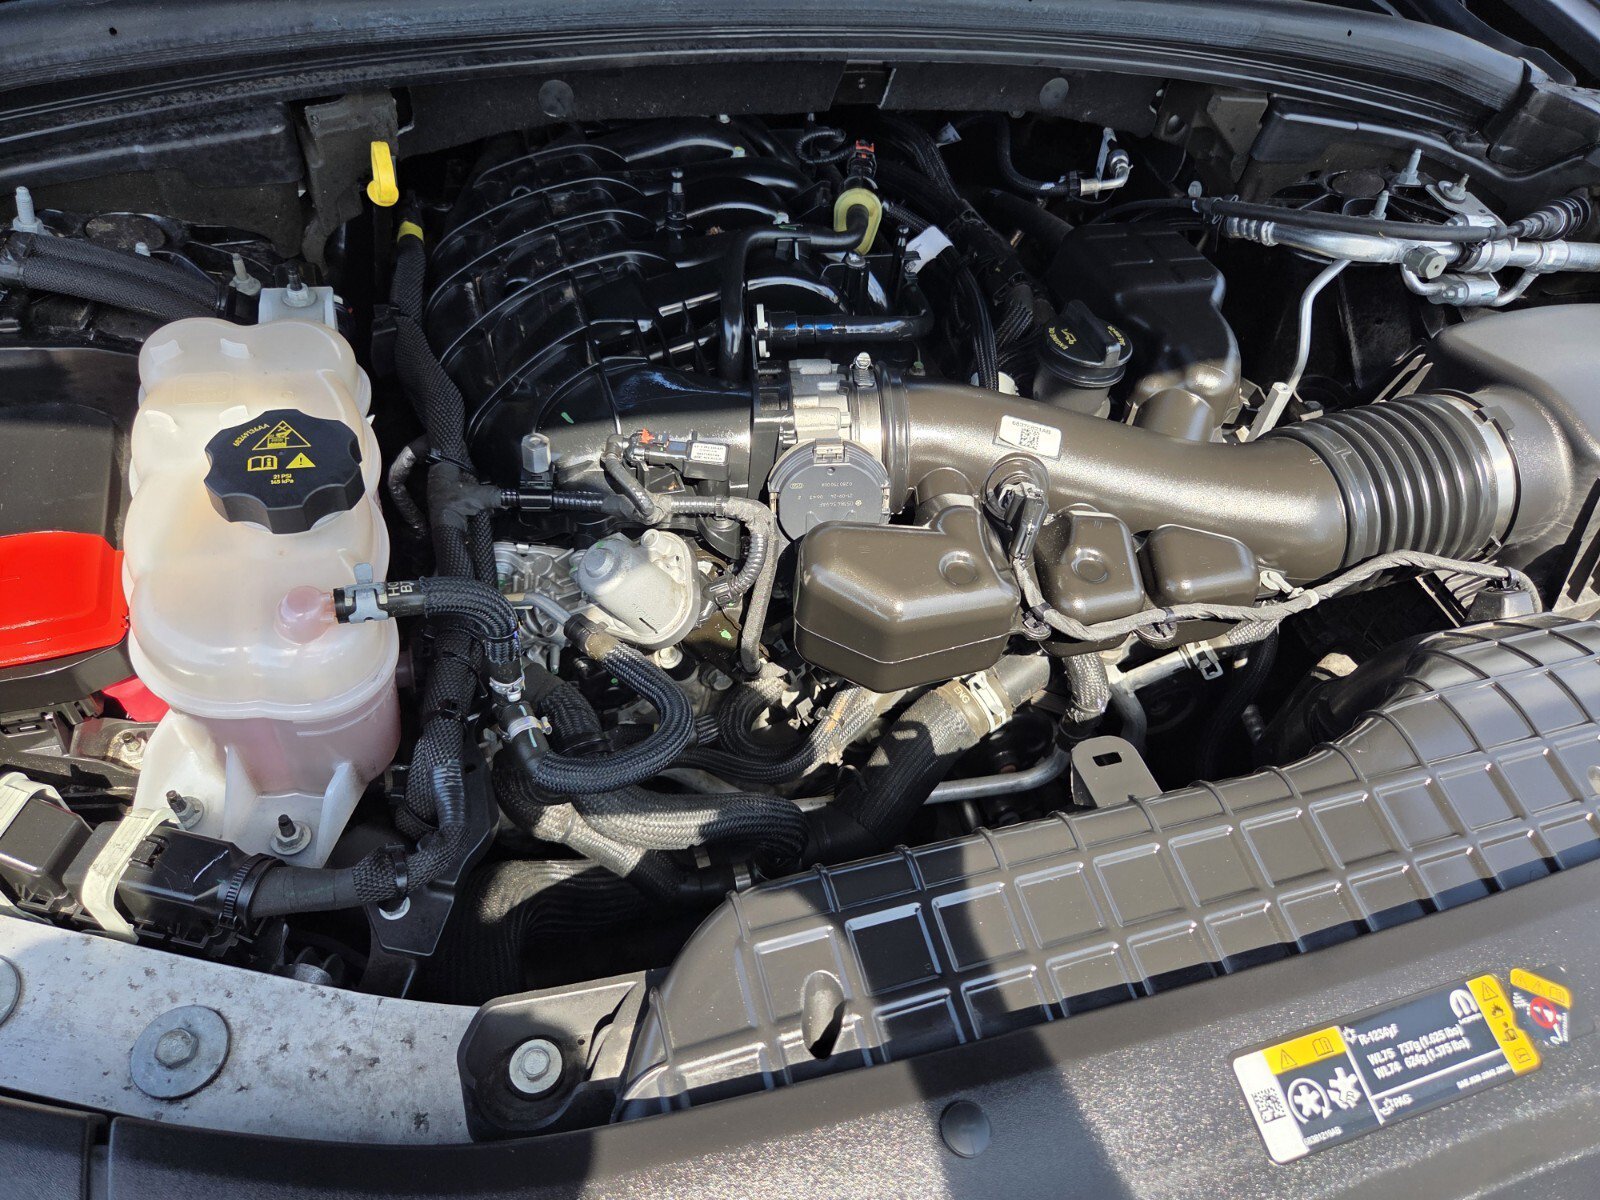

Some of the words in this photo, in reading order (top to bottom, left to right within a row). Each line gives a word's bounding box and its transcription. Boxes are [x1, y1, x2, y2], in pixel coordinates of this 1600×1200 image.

[954, 687, 969, 703] ENG
[1444, 1024, 1465, 1041] lbs)
[1450, 1037, 1472, 1052] lbs)
